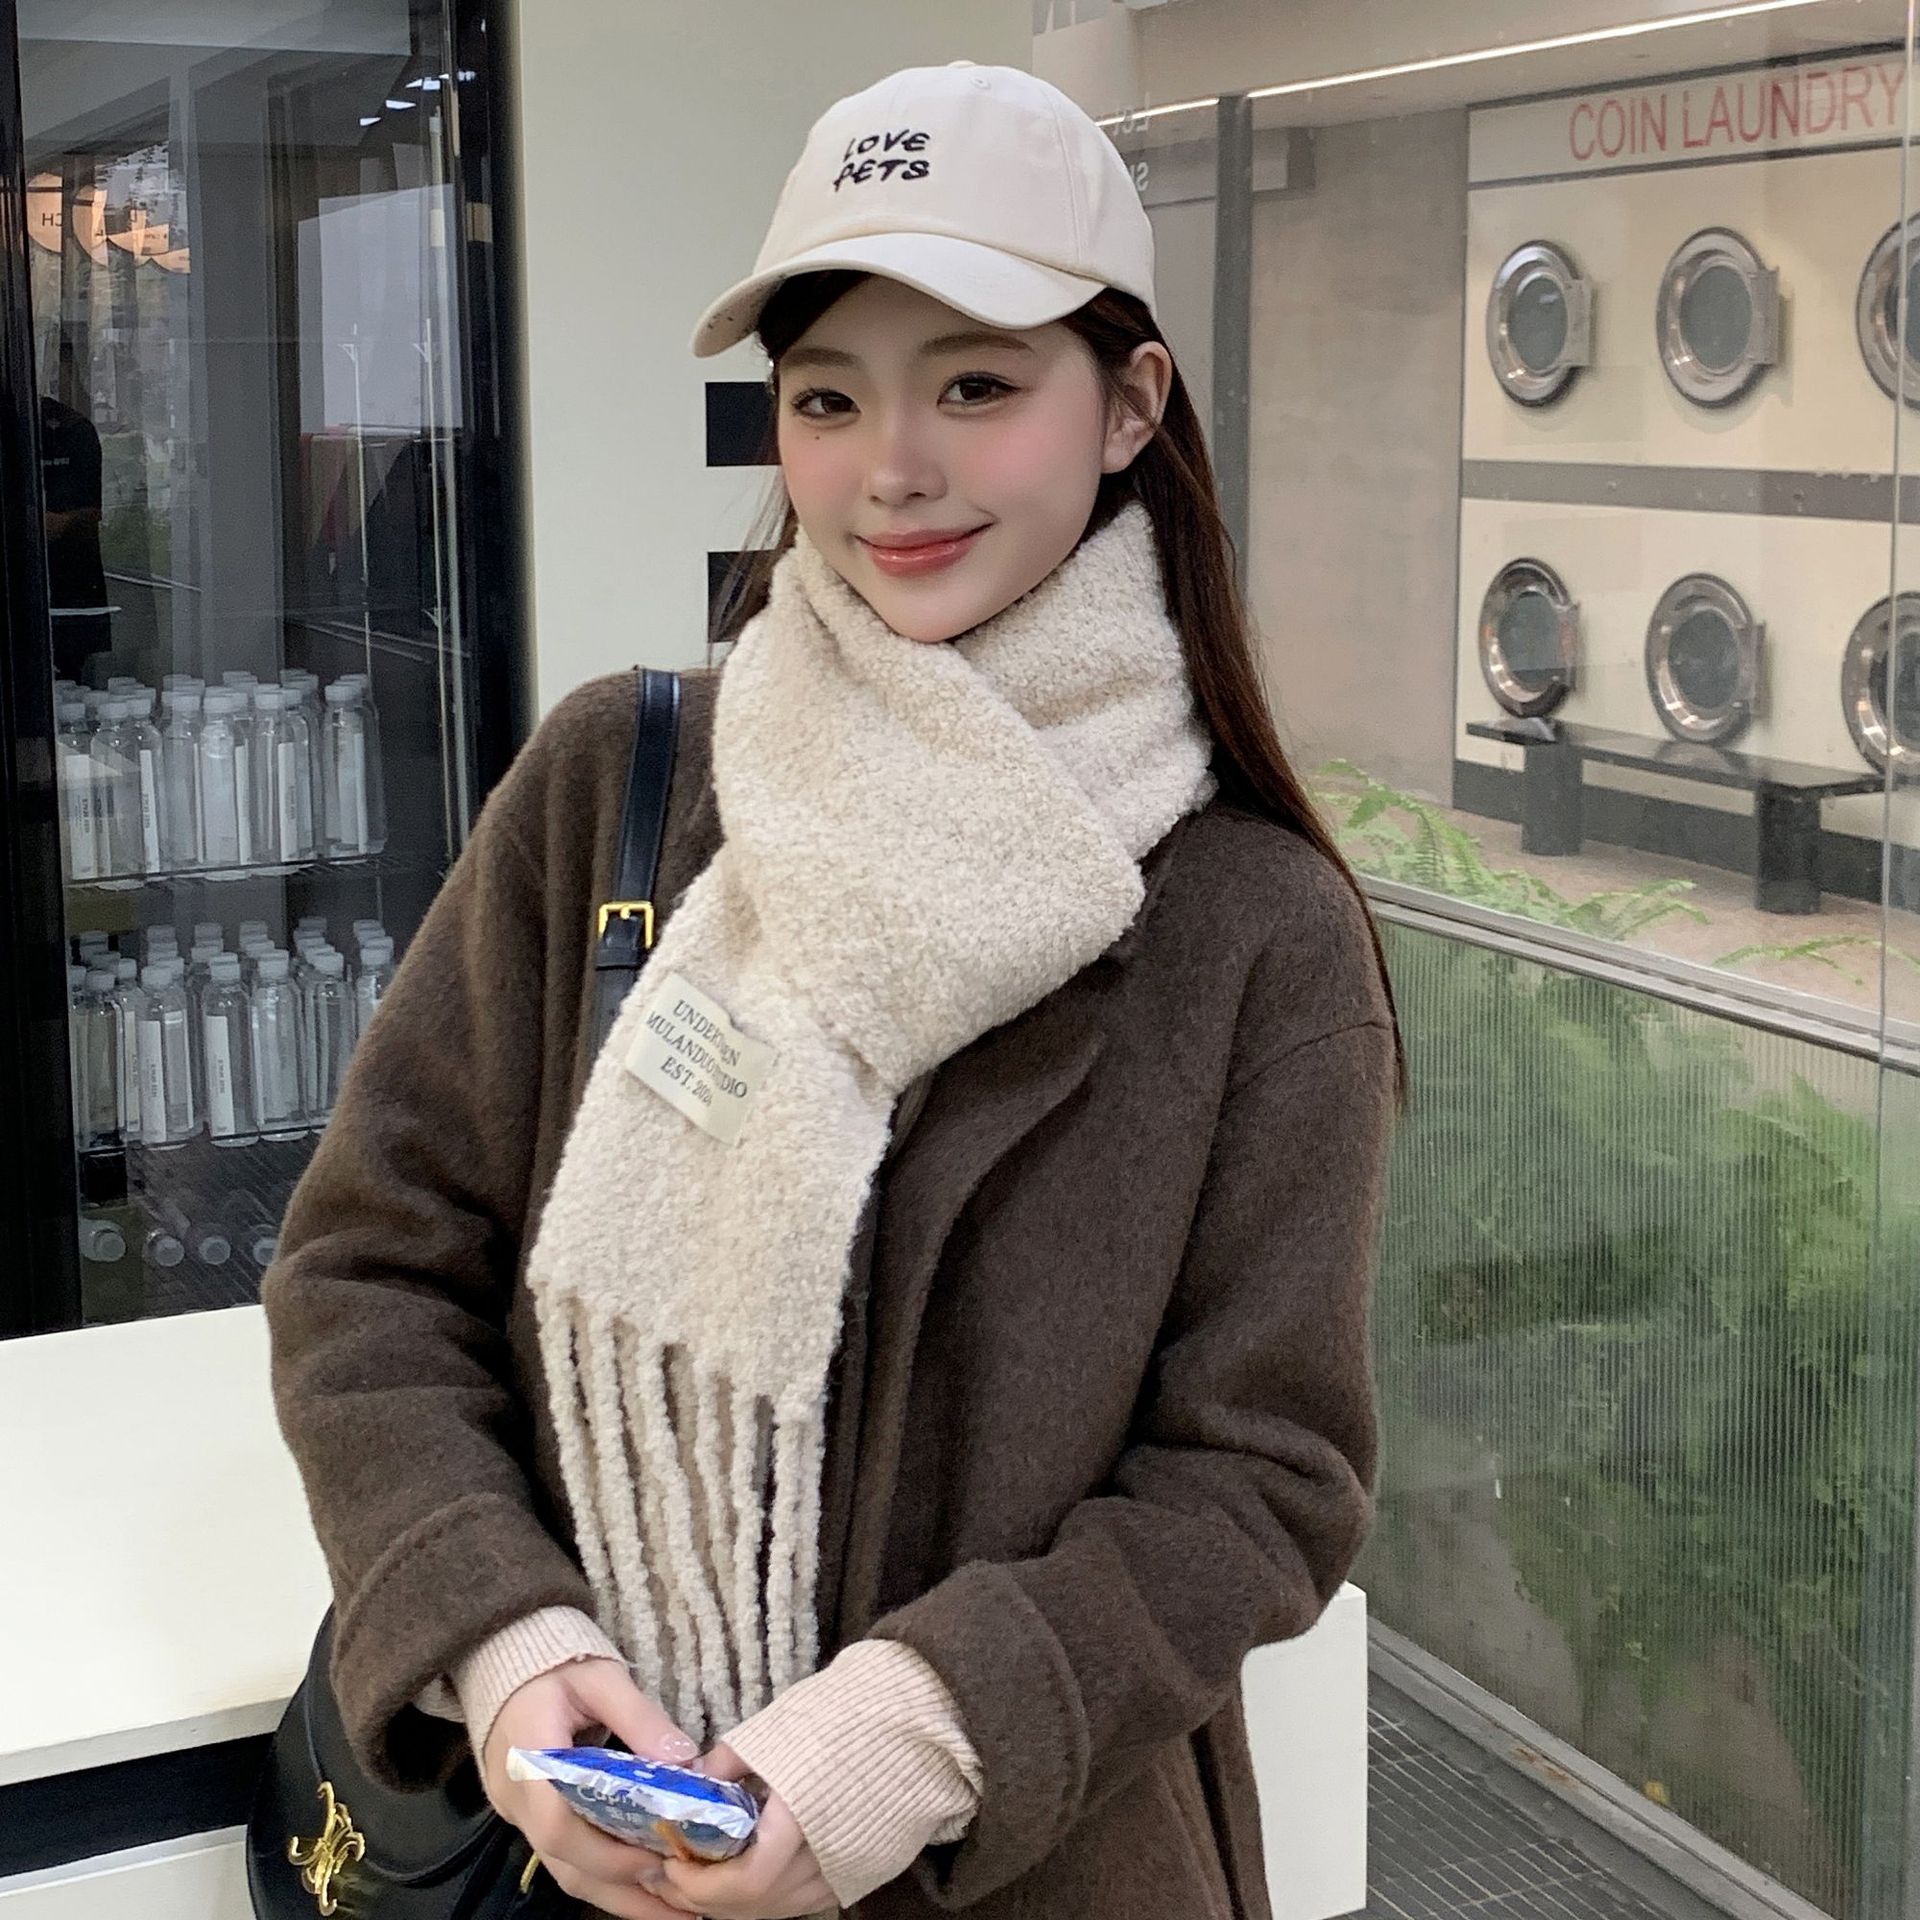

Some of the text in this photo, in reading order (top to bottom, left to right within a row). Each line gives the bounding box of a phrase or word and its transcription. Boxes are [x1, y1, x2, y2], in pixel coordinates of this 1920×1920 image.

[1569, 62, 1906, 160] COIN LAUNDRY
[843, 129, 930, 162] LOVE
[833, 159, 929, 192] PETS
[660, 1056, 691, 1090] EST.
